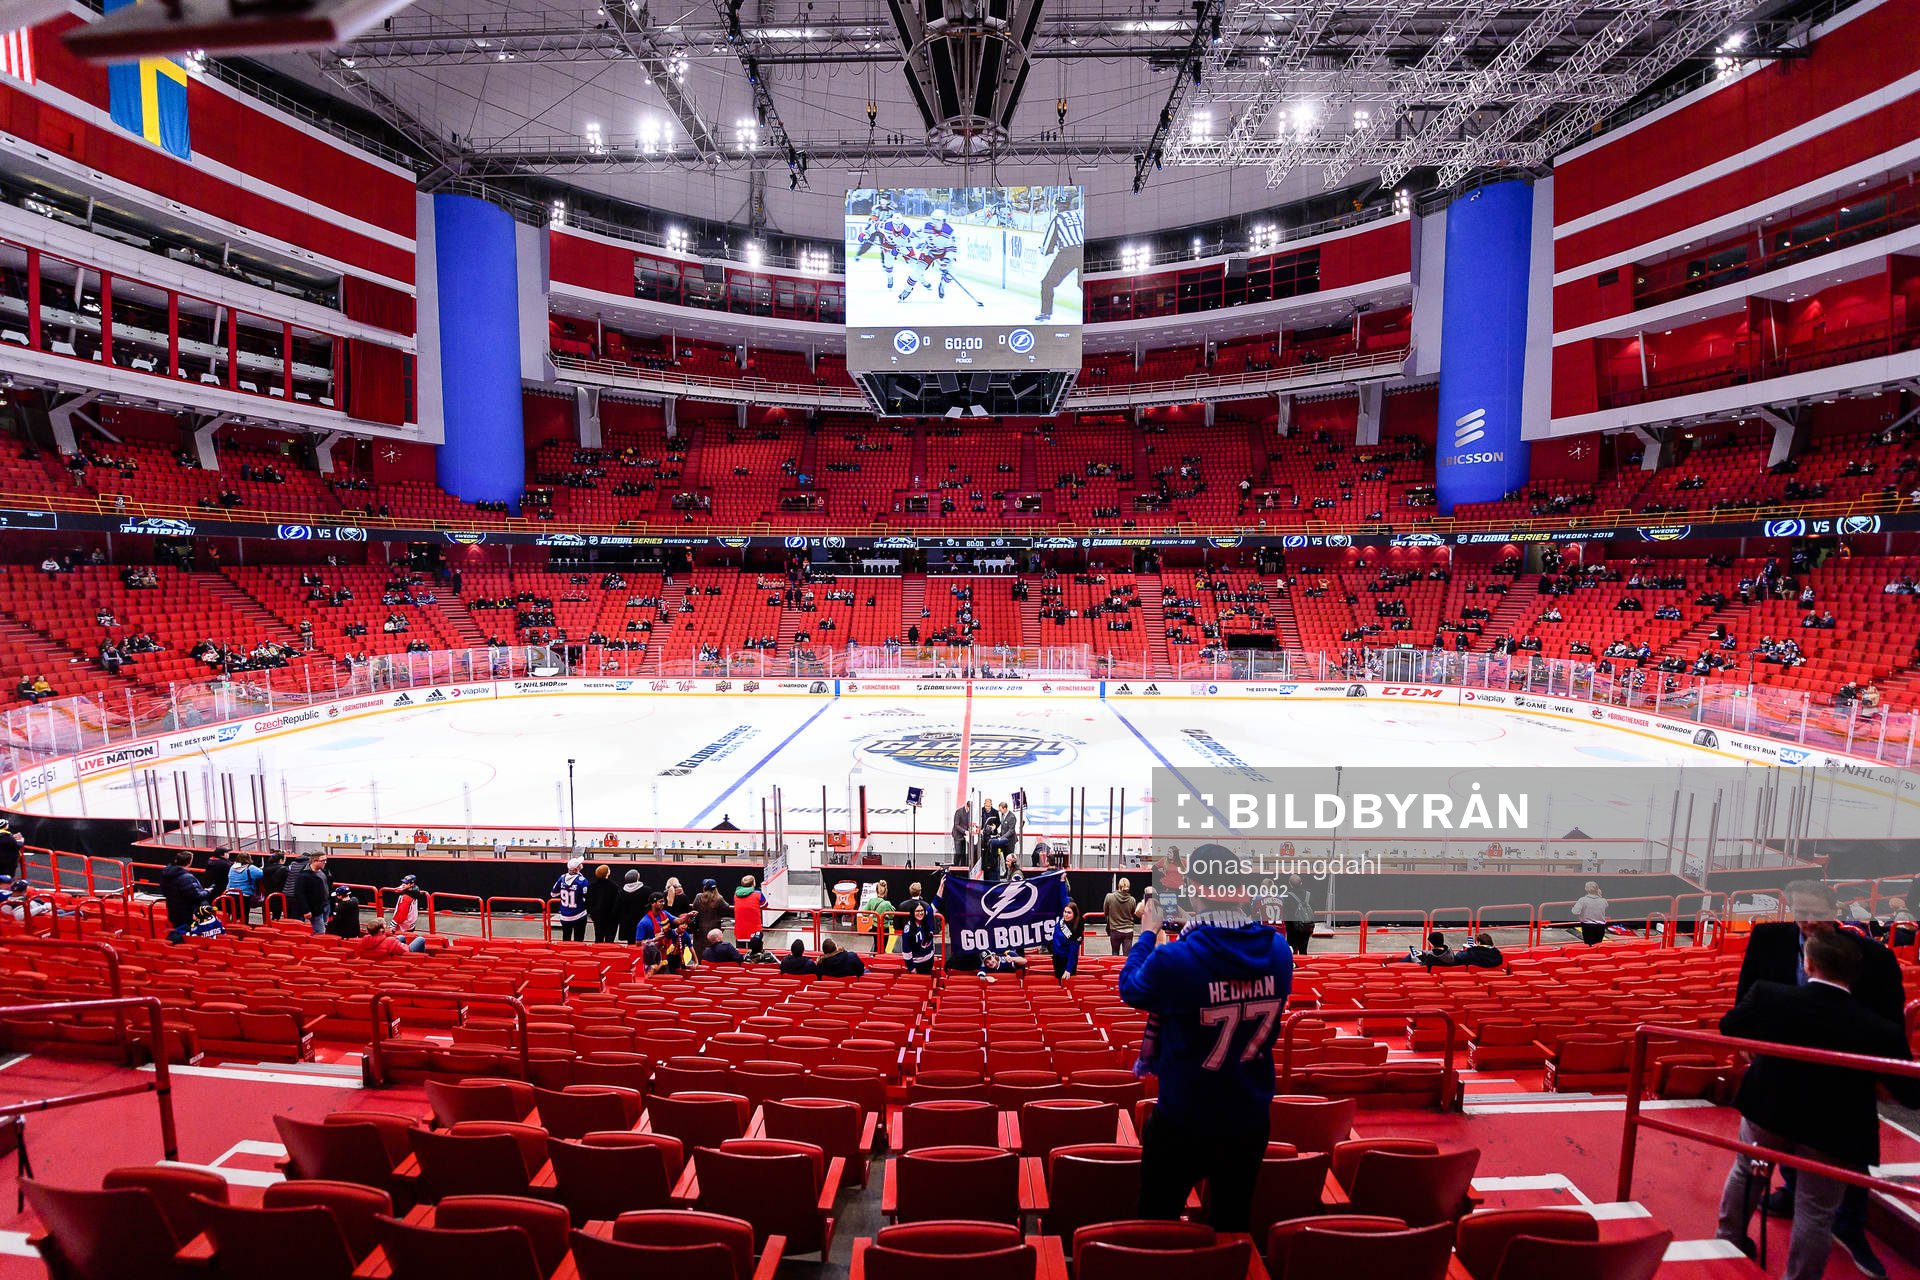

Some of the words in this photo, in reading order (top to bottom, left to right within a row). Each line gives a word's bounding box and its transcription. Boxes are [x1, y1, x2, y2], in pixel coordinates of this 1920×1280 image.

[923, 336, 930, 346] 0
[945, 337, 983, 350] 60:00
[998, 335, 1005, 345] 0
[1812, 521, 1830, 533] VS
[317, 528, 331, 538] VS
[810, 538, 820, 546] VS
[1312, 537, 1323, 546] VS
[462, 686, 489, 695] viaplay
[1381, 687, 1443, 698] CCM
[393, 699, 414, 707] adidas
[426, 695, 447, 703] adidas
[1476, 694, 1506, 703] viaplay
[1554, 706, 1574, 714] WEEK
[170, 741, 183, 750] THE
[184, 738, 201, 747] BEST
[202, 734, 216, 742] RUN
[219, 727, 238, 739] SAP
[1731, 740, 1742, 748] THE
[1744, 743, 1760, 752] BEST
[1762, 748, 1777, 756] RUN
[1780, 752, 1804, 764] SAP
[78, 757, 105, 771] LIVE
[106, 746, 154, 765] NATION
[23, 766, 57, 795] pepsi
[560, 889, 577, 909] 91
[960, 928, 990, 951] GO
[1208, 975, 1275, 1004] HEDMAN
[1200, 998, 1282, 1072] 77
